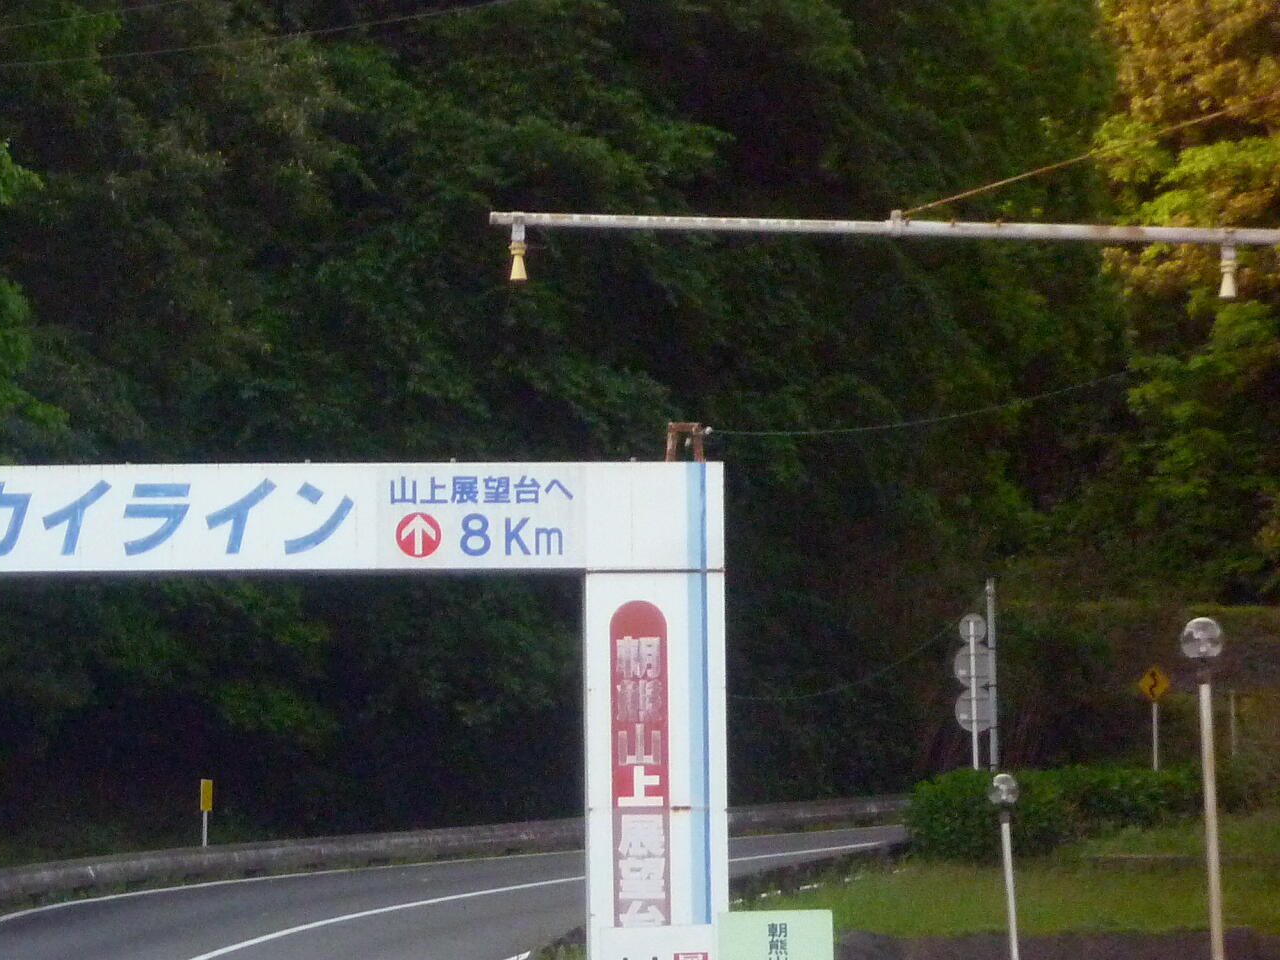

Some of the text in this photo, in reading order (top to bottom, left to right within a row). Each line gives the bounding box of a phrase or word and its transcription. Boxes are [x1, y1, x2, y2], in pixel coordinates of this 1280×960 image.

[389, 475, 574, 505] 山上展望台へ
